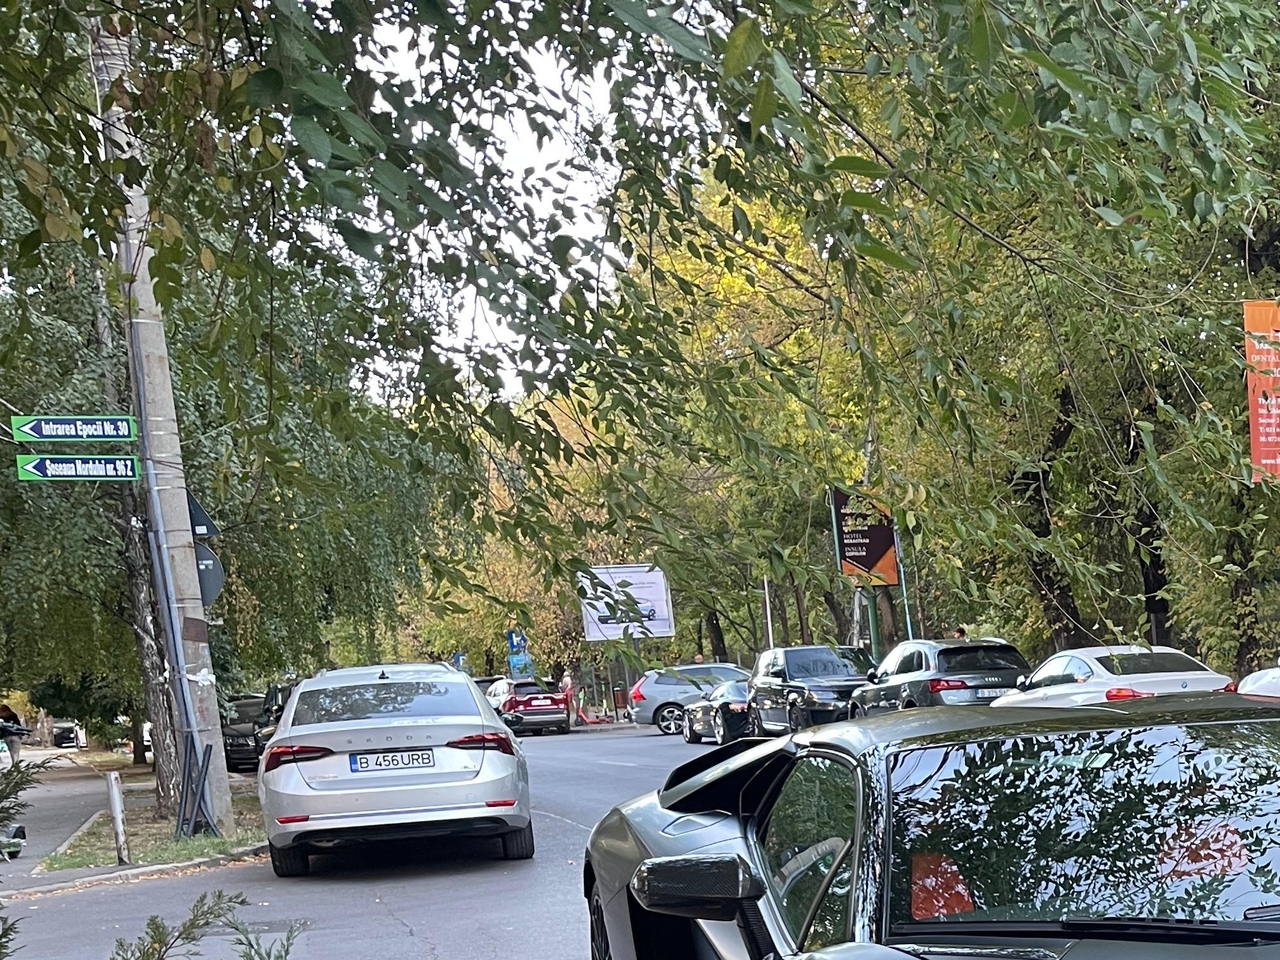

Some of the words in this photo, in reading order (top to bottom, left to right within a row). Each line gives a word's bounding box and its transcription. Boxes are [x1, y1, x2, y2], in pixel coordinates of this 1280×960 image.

[41, 421, 76, 435] Intrarea
[76, 421, 103, 438] Epocii
[103, 421, 117, 435] Nr.
[117, 421, 129, 435] 30
[75, 460, 106, 476] Nordului
[106, 463, 116, 475] nr.
[116, 460, 126, 476] 96
[126, 460, 133, 476] Z
[359, 757, 369, 769] B
[375, 754, 400, 767] 456
[401, 752, 431, 766] URB
